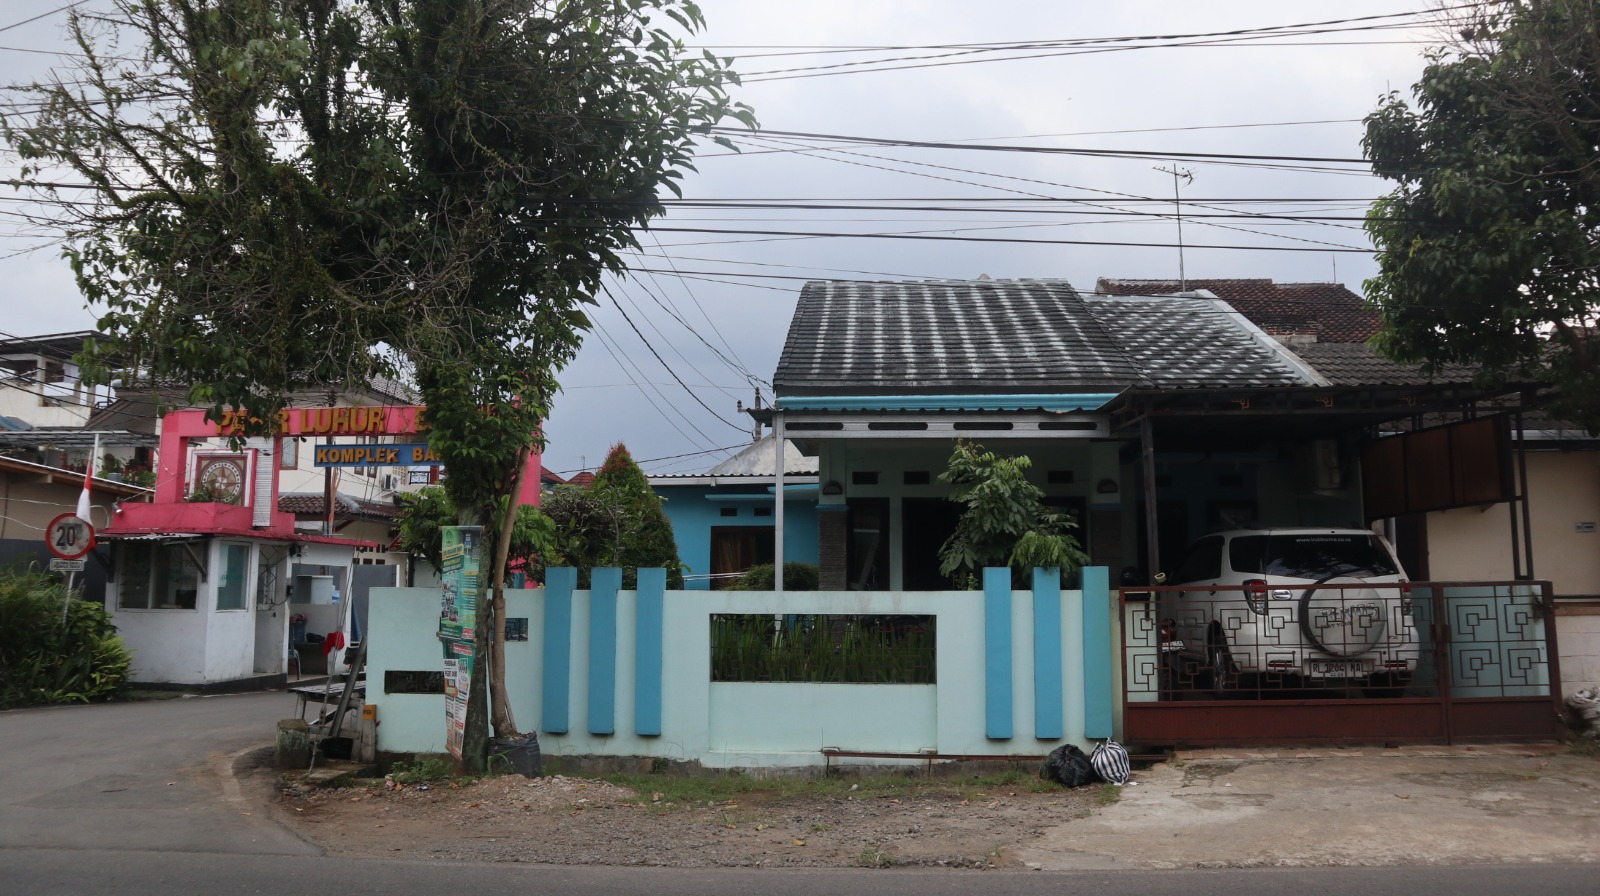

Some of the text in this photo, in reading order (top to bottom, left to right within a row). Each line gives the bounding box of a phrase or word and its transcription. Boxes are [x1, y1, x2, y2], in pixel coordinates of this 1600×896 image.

[215, 409, 290, 435] PAR
[301, 407, 386, 433] LUHUR
[316, 448, 399, 464] KOMPLEK
[56, 525, 75, 546] 20
